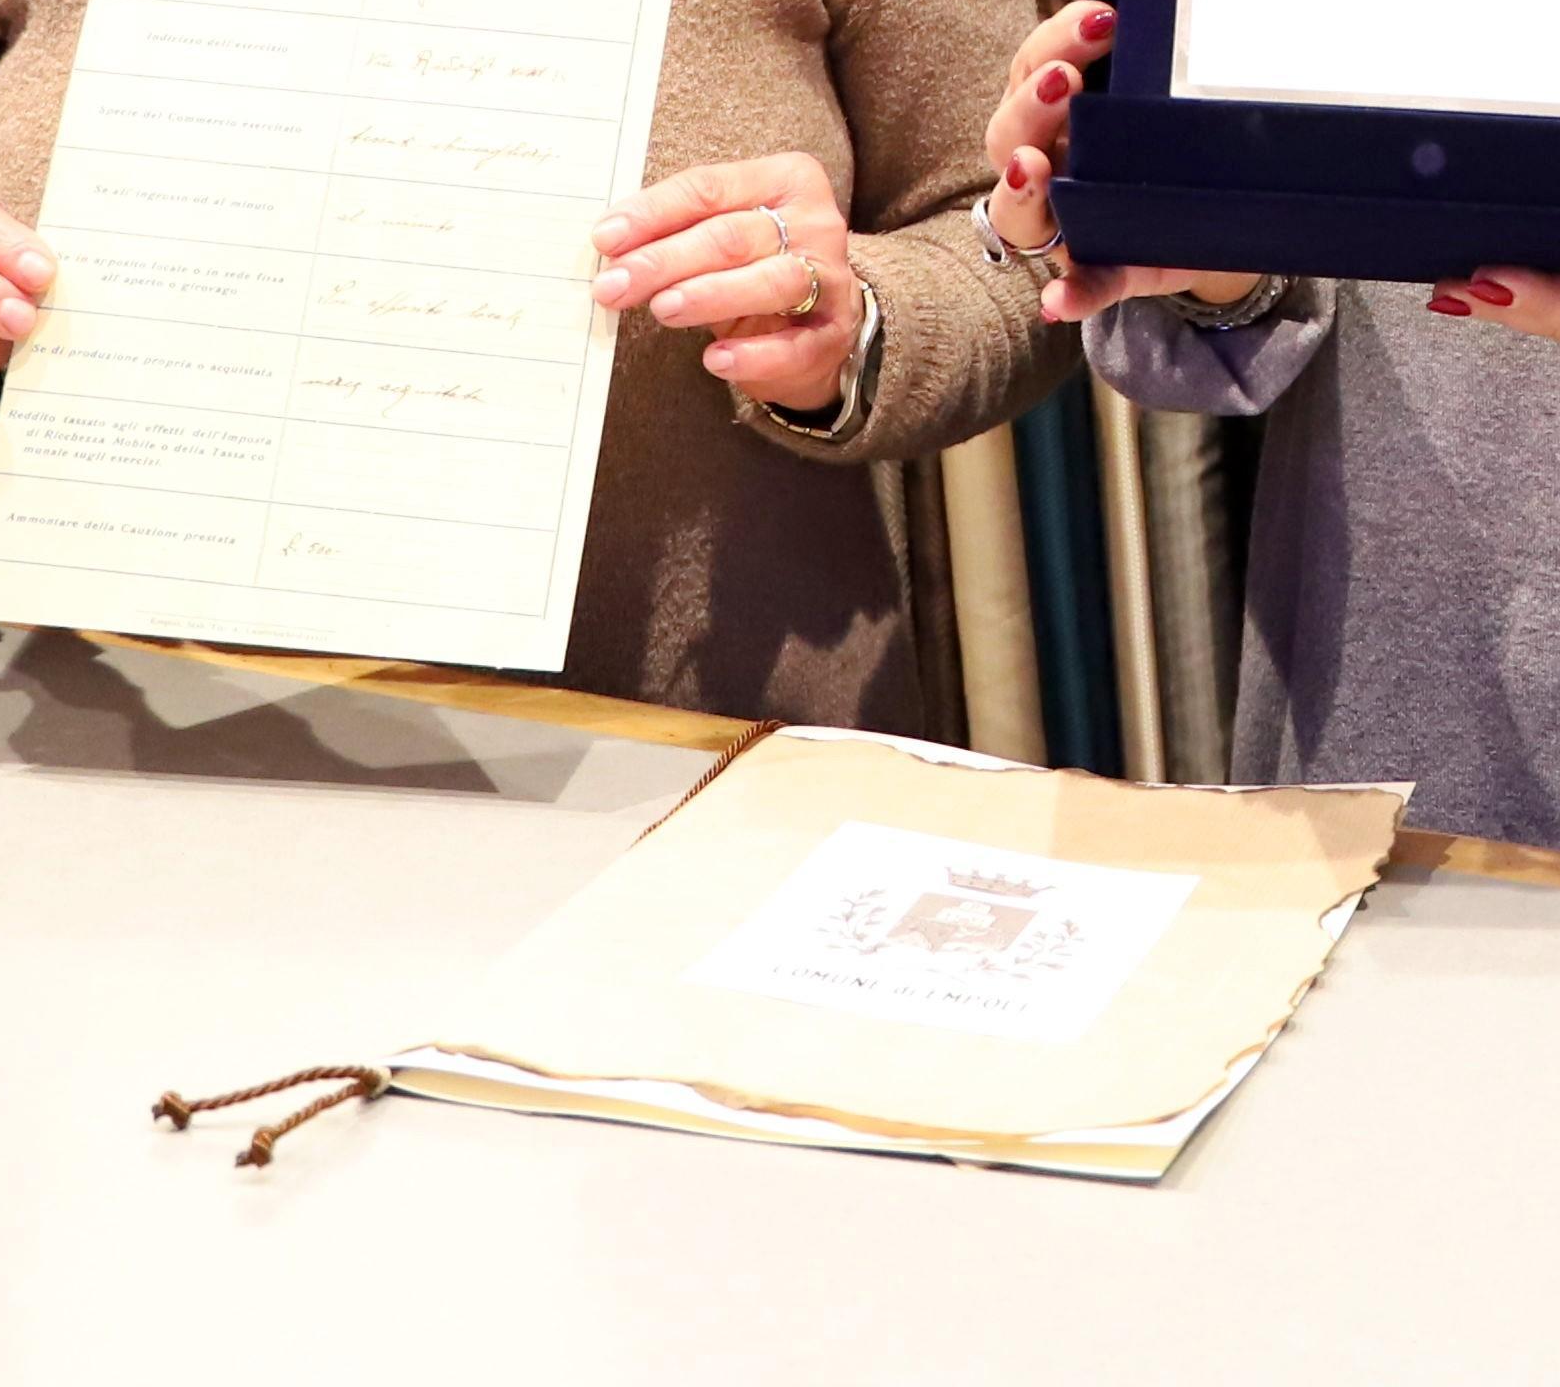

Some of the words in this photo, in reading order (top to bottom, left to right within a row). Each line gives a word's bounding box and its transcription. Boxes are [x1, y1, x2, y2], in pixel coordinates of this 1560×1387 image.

[146, 31, 202, 46] Indirizzo
[98, 104, 138, 119] Specie
[142, 110, 163, 119] del
[167, 112, 237, 127] Commercio
[242, 120, 303, 134] esercitato
[93, 184, 108, 195] Se
[136, 189, 188, 203] ingrosso
[213, 196, 224, 207] al
[230, 199, 275, 212] minuto
[75, 253, 89, 263] in
[93, 255, 147, 269] apposito
[151, 260, 188, 274] locale
[206, 267, 219, 276] in
[224, 268, 251, 281] sede
[255, 271, 285, 284] fissa
[123, 275, 164, 289] aperto
[180, 281, 239, 297] girovago
[32, 343, 46, 354] Se
[51, 345, 65, 355] di
[69, 348, 138, 363] produzione
[143, 354, 192, 370] propria
[209, 363, 273, 378] acquistata
[7, 408, 56, 423] Reddito
[63, 415, 106, 428] tassato
[111, 420, 139, 433] agli
[144, 424, 185, 436] effetti
[23, 445, 68, 458] munale
[73, 450, 106, 462] sugli
[25, 429, 39, 438] di
[43, 429, 105, 444] Ricchezza
[111, 435, 156, 450] Mobile
[161, 443, 168, 451] o
[173, 442, 205, 455] della
[212, 446, 245, 458] Tassa
[6, 512, 79, 528] Ammontare
[84, 520, 115, 532] della
[120, 523, 178, 538] Cauzione
[183, 531, 236, 545] prestata
[772, 964, 879, 990] COMUNE
[893, 984, 916, 996] di
[925, 989, 1030, 1012] EMPOLI
